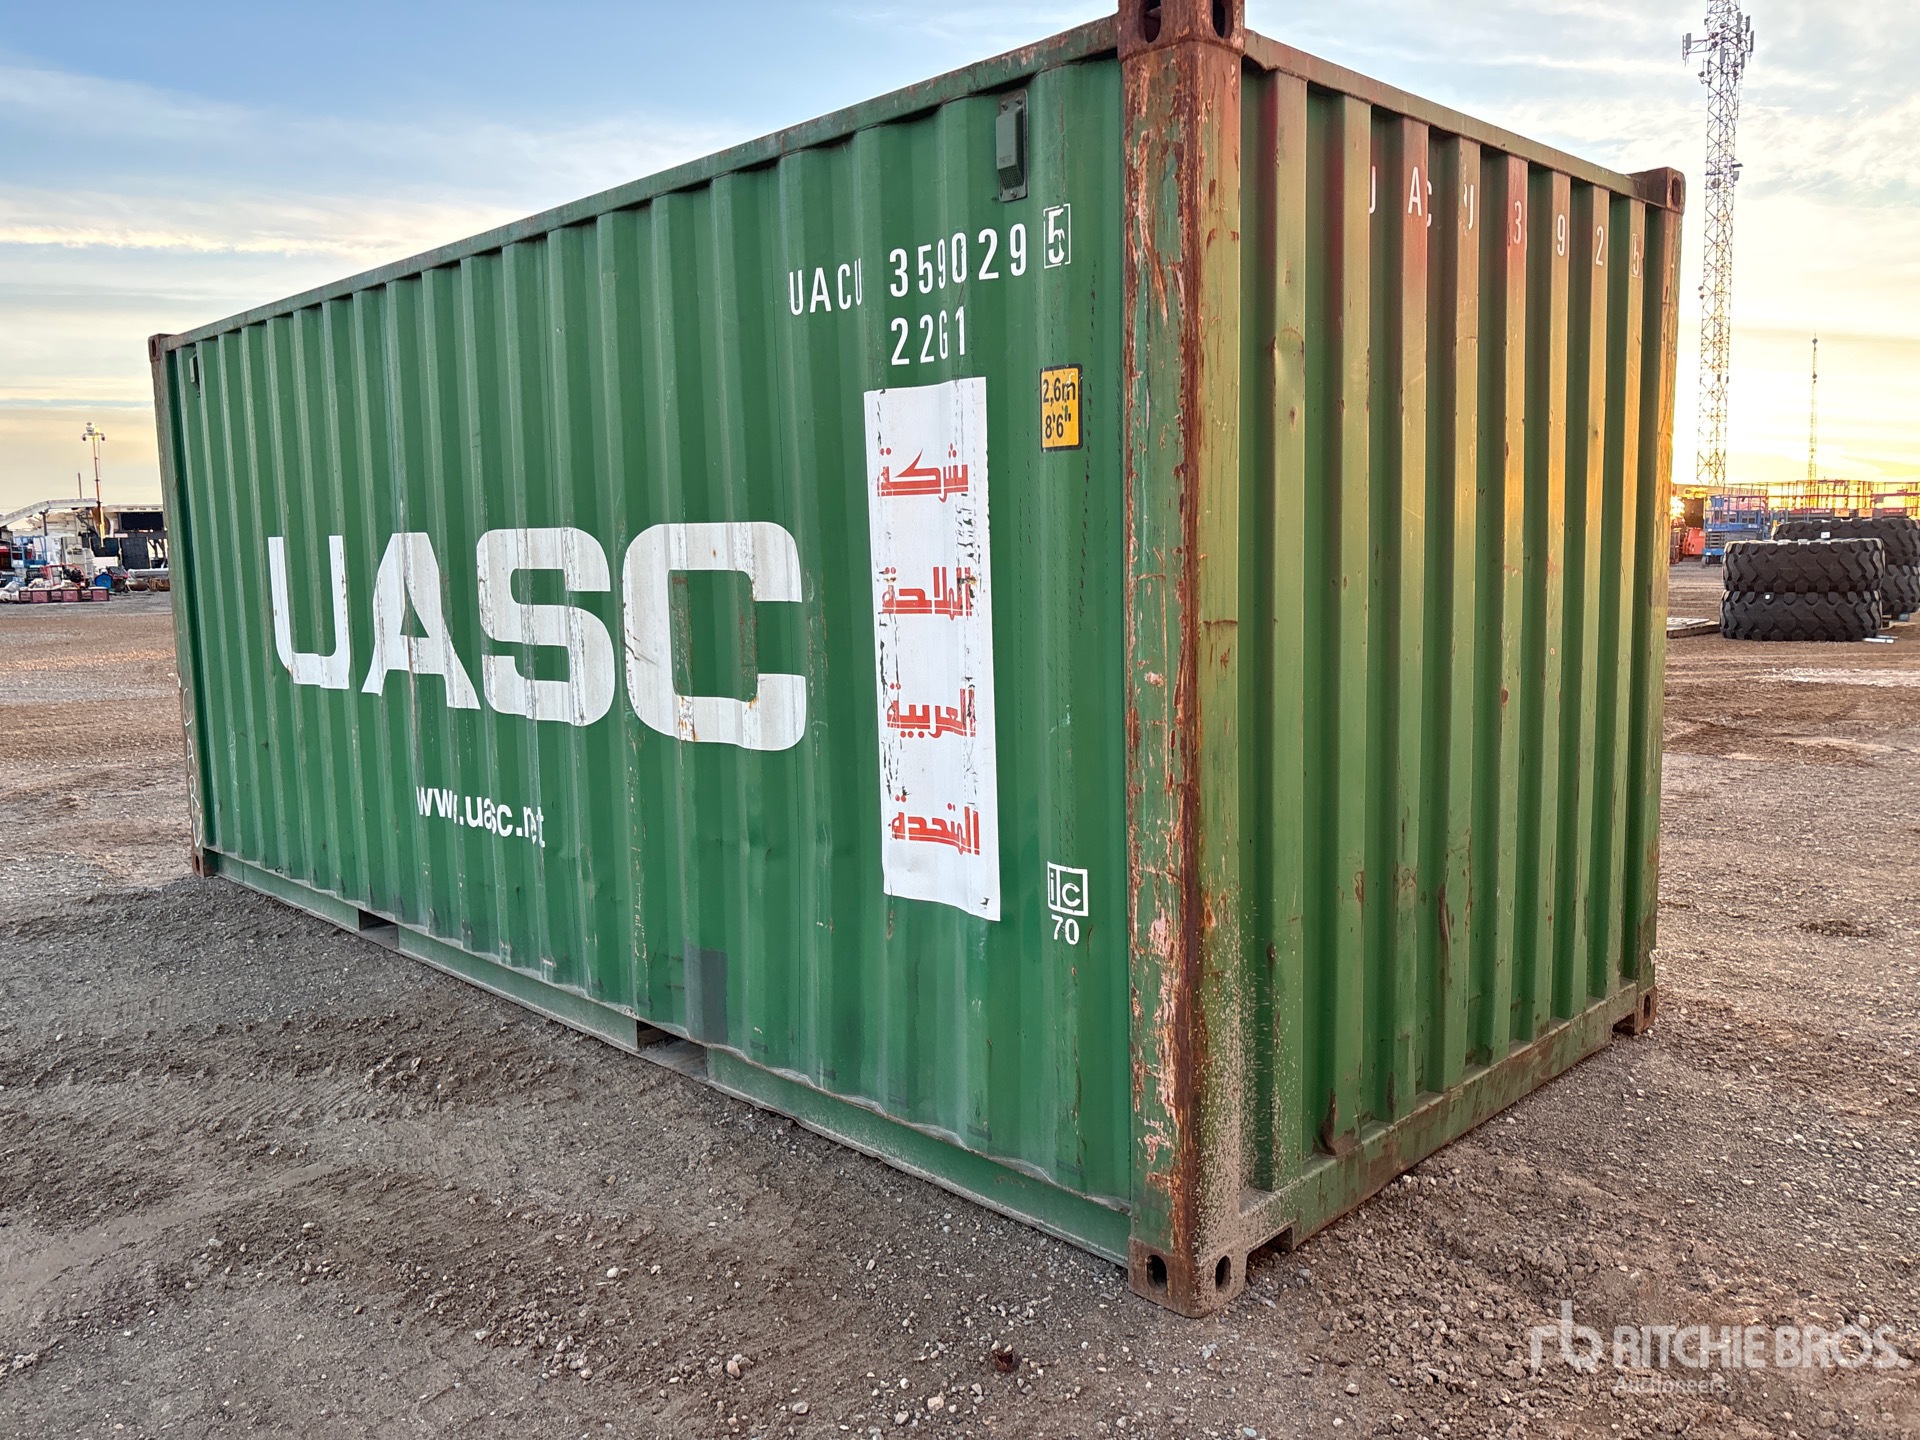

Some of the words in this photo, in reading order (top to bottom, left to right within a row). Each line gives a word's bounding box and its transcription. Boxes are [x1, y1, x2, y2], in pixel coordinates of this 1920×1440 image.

[788, 256, 862, 316] UACU
[889, 223, 1027, 298] 359029
[1046, 206, 1066, 265] 5
[890, 305, 966, 366] 22G1
[1043, 376, 1077, 407] 2,6m
[876, 442, 969, 503] شركة
[881, 566, 974, 621] الملاحة
[267, 521, 808, 751] UASC
[886, 683, 977, 738] العربية
[890, 794, 981, 856] المتحدة
[1051, 914, 1080, 945] 70
